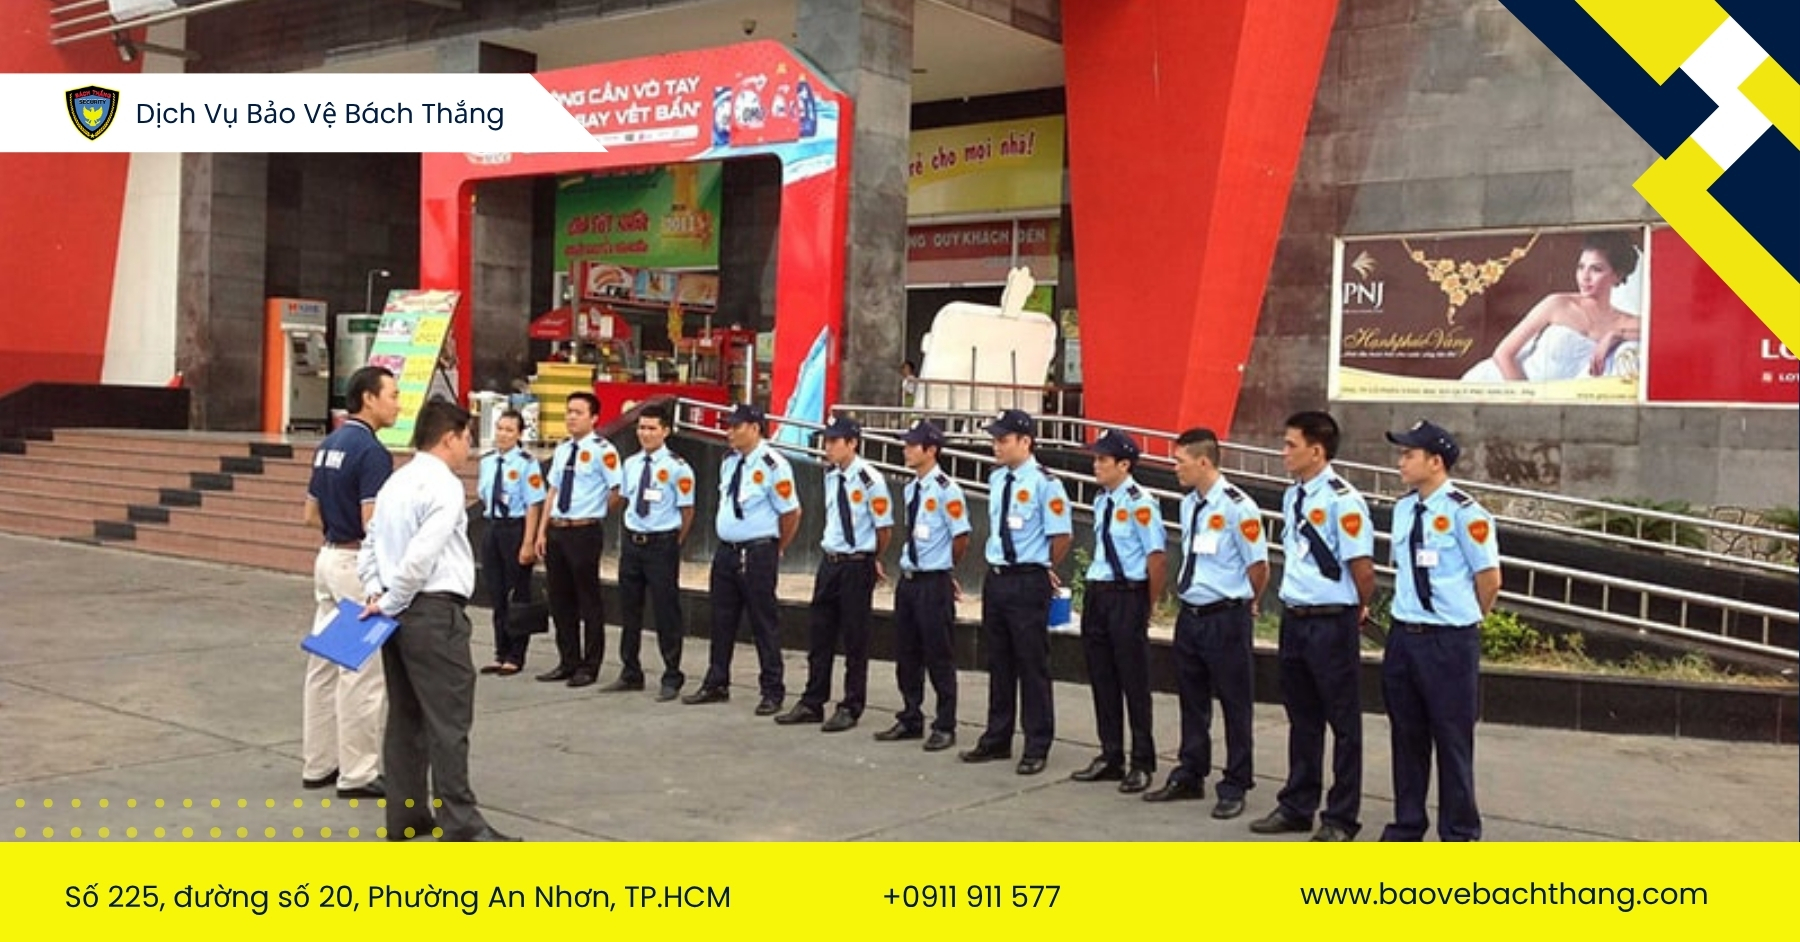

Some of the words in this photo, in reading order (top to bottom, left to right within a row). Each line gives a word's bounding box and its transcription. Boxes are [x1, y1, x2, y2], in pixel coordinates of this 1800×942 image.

[664, 75, 700, 95] TAY
[931, 145, 957, 170] cho
[1343, 281, 1384, 308] PNJ
